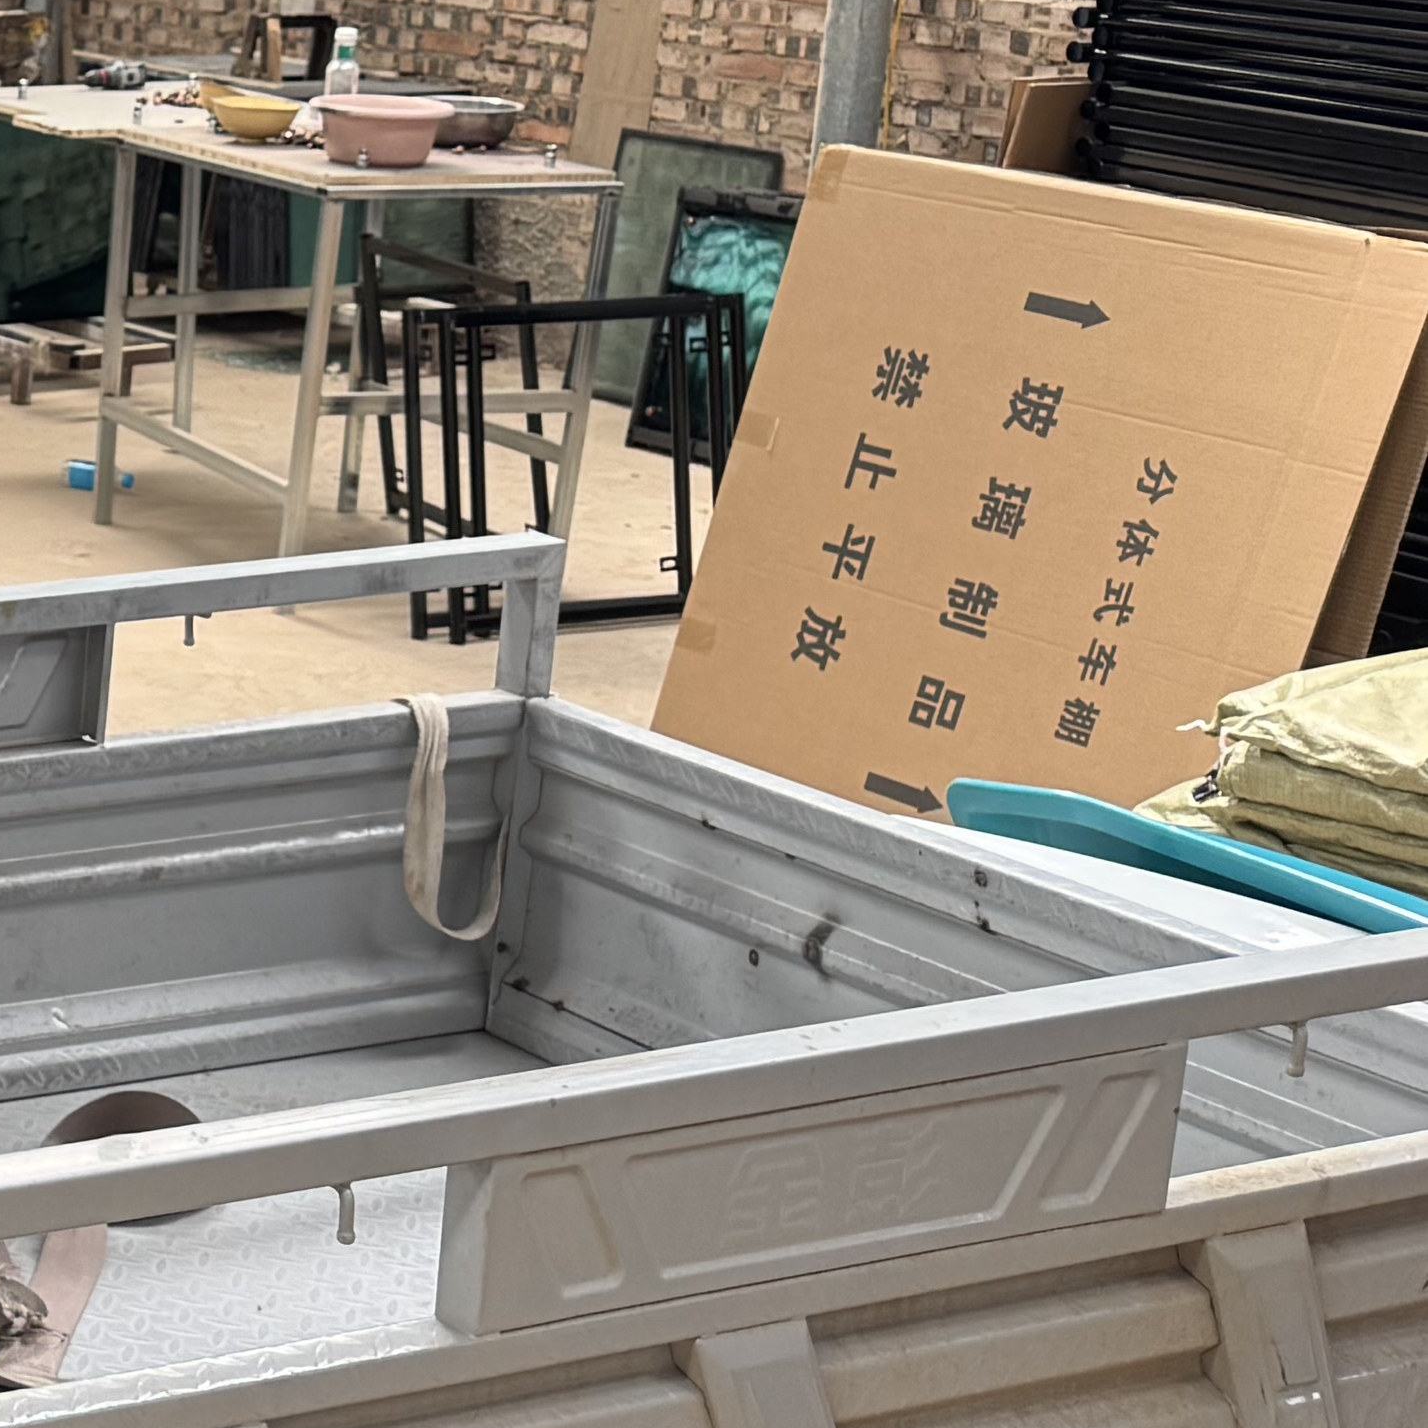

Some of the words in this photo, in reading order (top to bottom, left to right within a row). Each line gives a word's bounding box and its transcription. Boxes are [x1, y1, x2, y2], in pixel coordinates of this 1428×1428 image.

[790, 345, 931, 672] 禁止平放
[908, 377, 1065, 732] 玻璃制品
[1055, 456, 1178, 749] 分体式车棚
